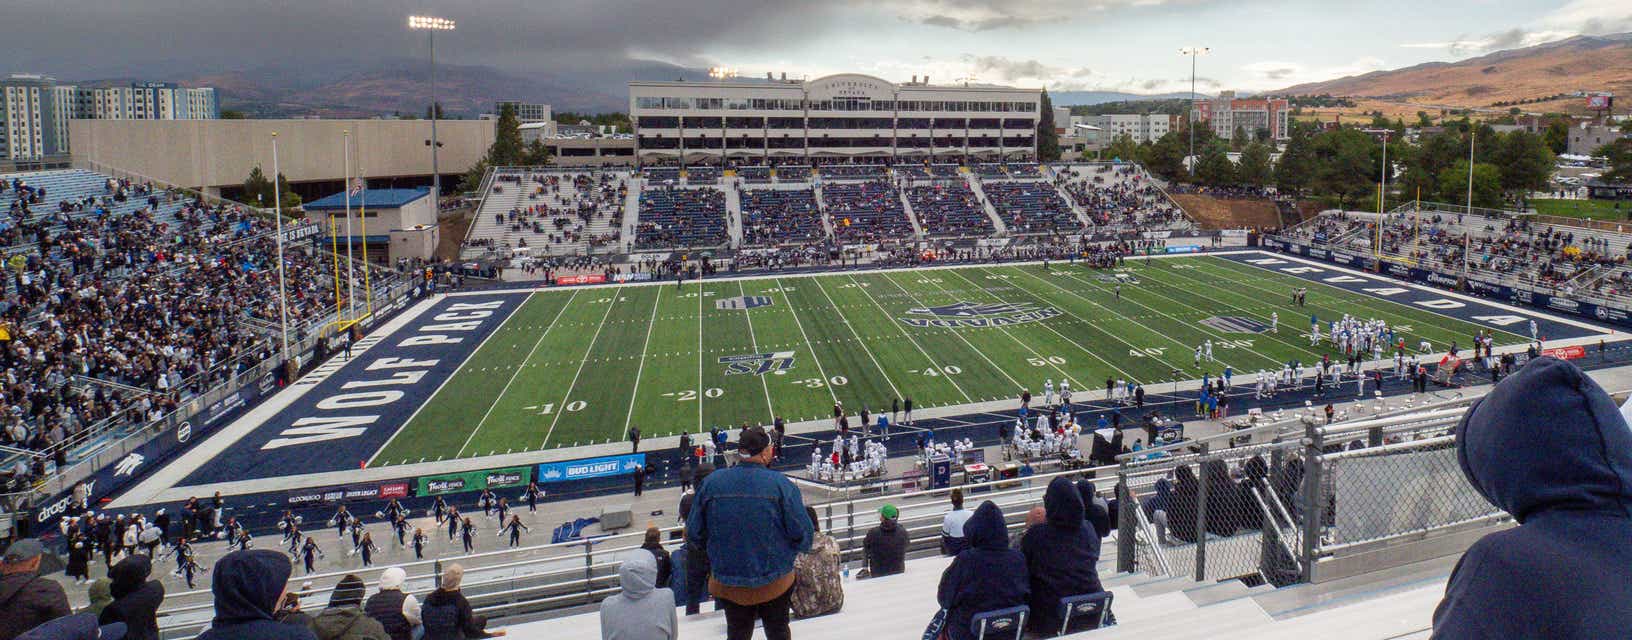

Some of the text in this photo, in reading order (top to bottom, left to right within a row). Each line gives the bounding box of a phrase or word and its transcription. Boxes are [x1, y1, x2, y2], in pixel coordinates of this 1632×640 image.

[397, 300, 504, 347] PACK
[1026, 355, 1067, 367] 50
[923, 365, 962, 377] 40
[805, 376, 848, 388] 30
[676, 387, 724, 401] 20
[261, 357, 440, 450] WOLF
[537, 400, 587, 415] 10
[568, 462, 617, 476] BUD LIGHT
